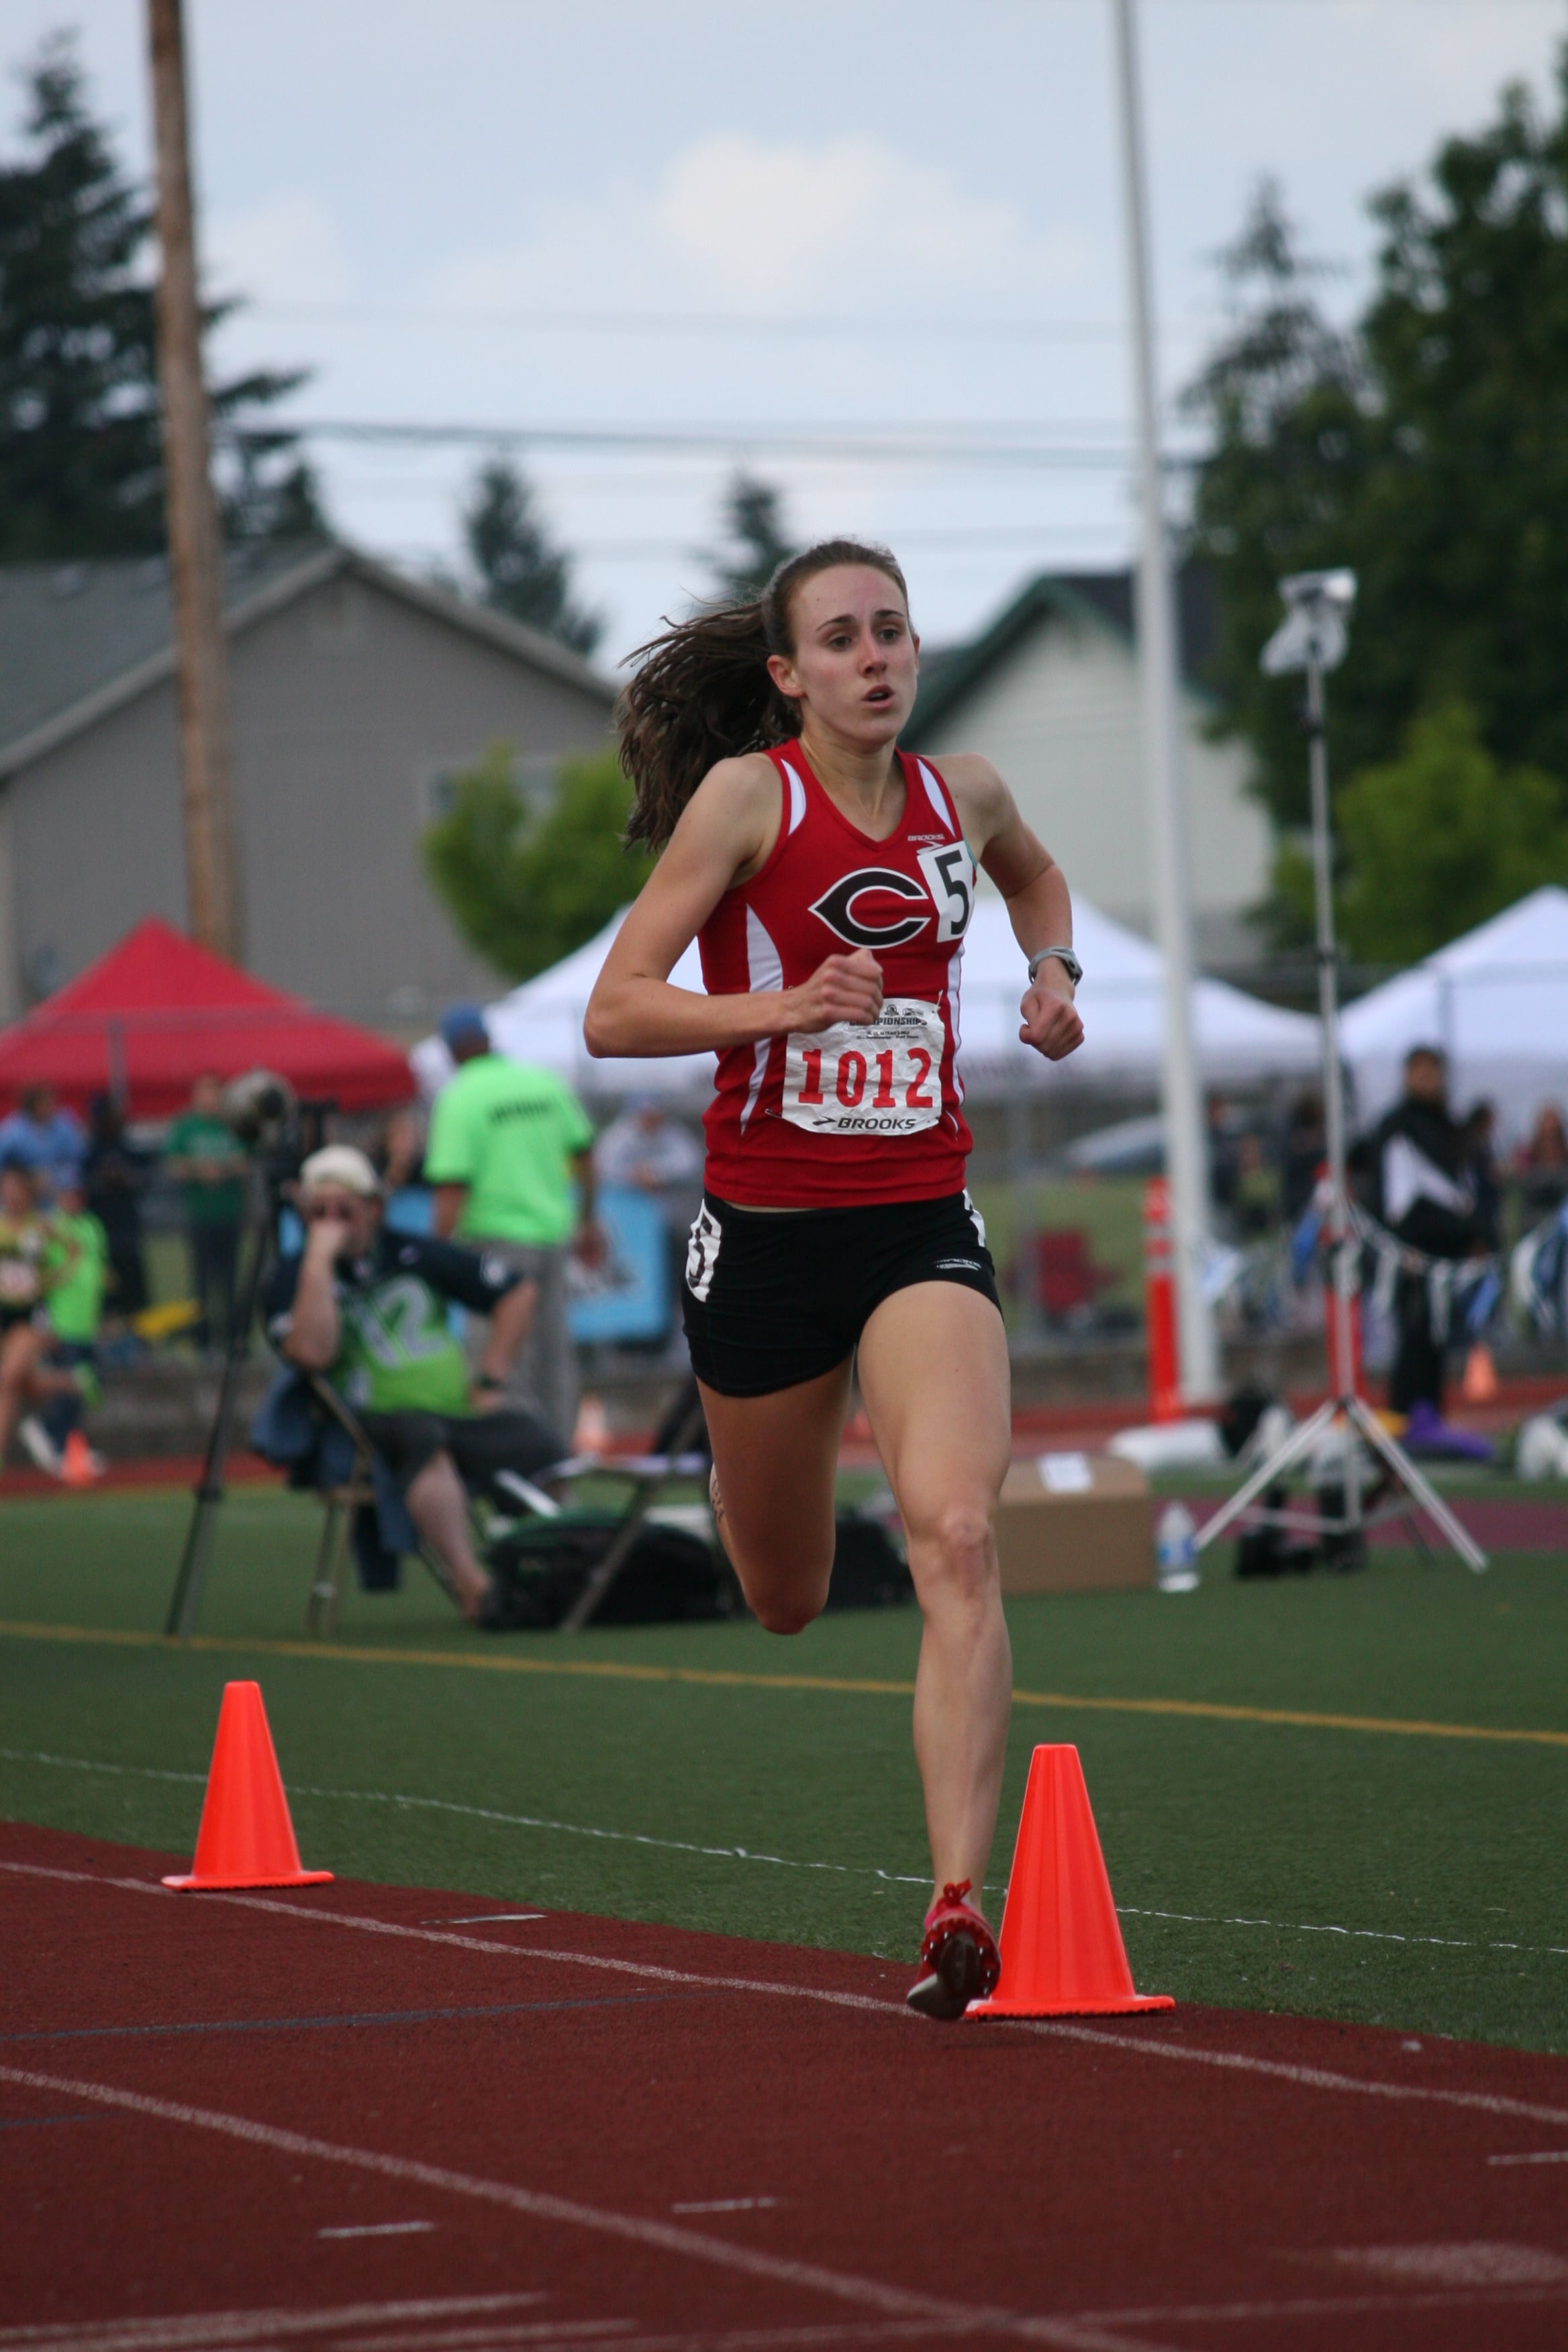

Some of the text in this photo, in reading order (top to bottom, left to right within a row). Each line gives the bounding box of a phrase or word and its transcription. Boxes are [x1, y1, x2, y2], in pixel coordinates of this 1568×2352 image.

[808, 868, 930, 948] C
[935, 850, 969, 935] 5
[799, 1047, 933, 1108] 1012
[838, 1118, 916, 1129] BROOKS
